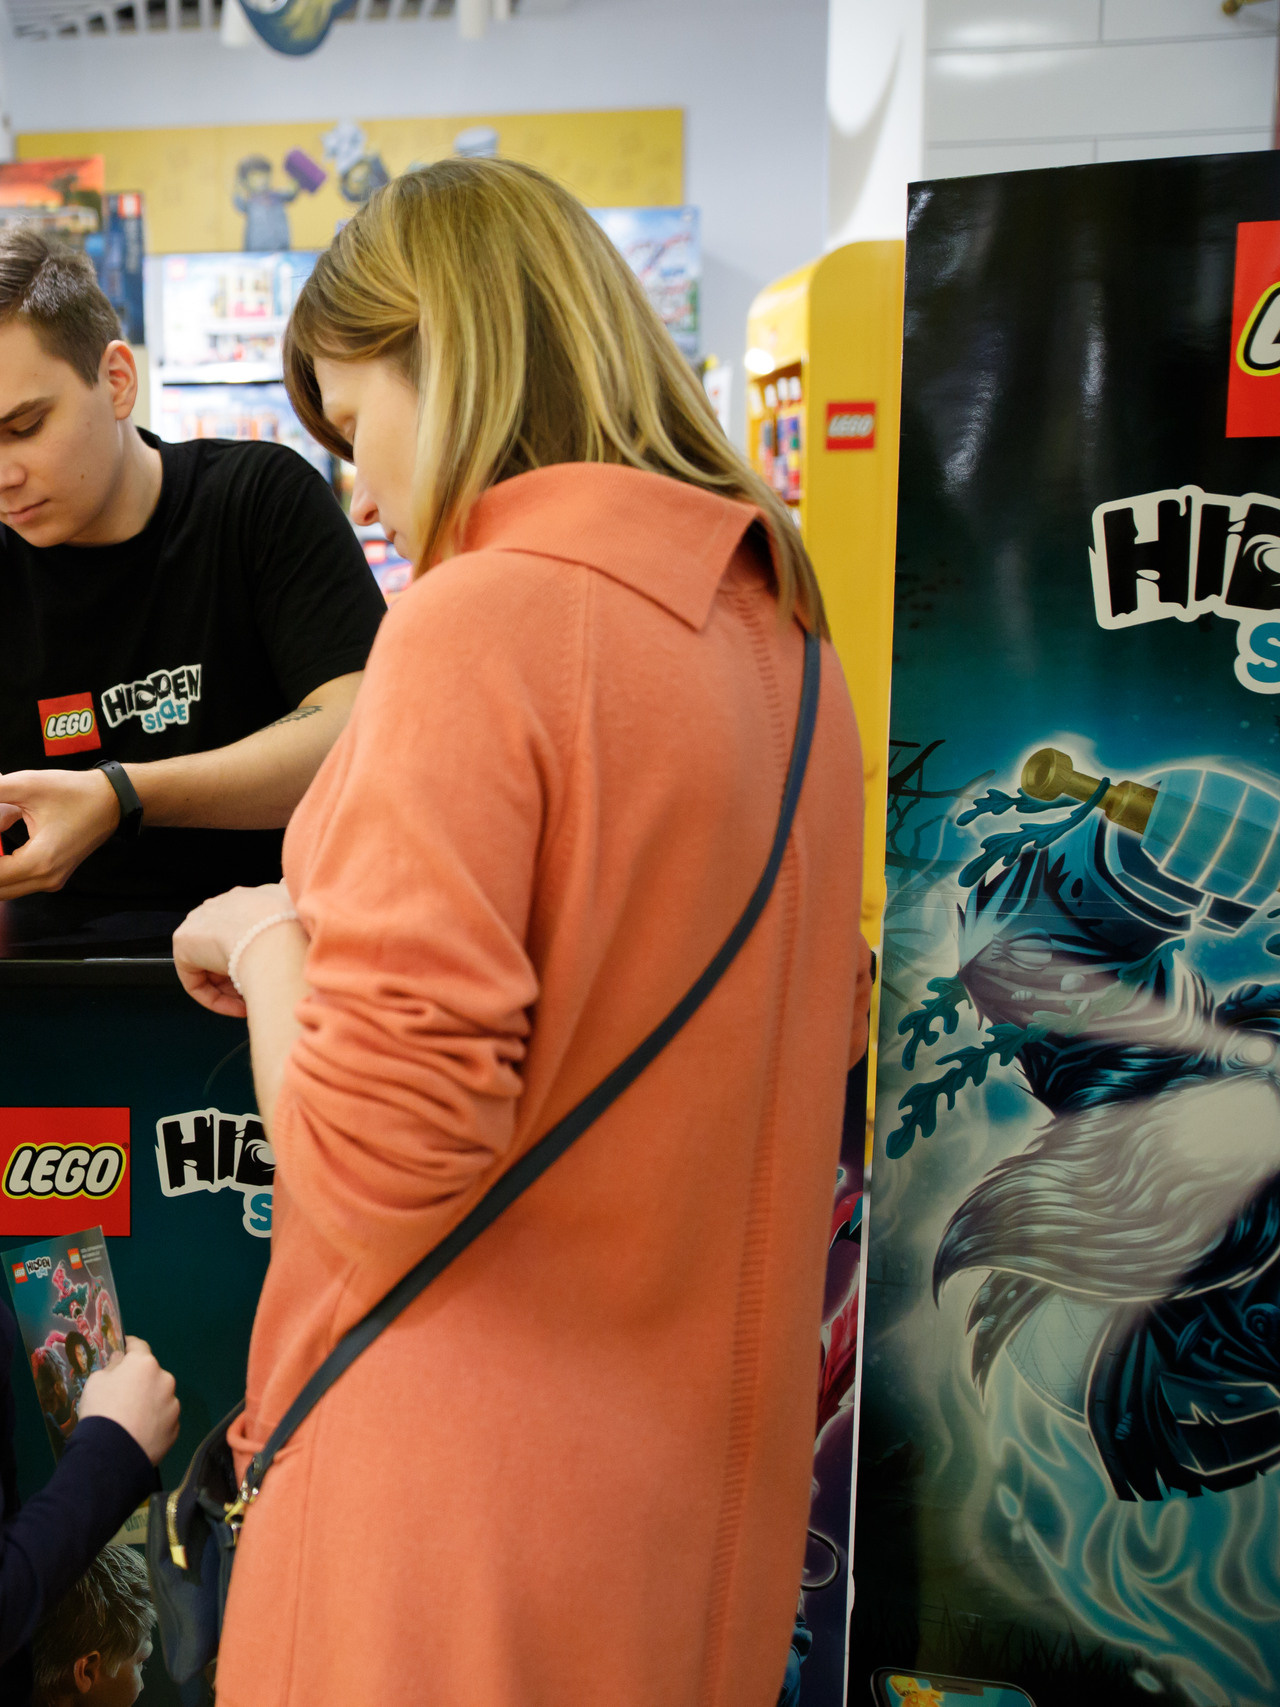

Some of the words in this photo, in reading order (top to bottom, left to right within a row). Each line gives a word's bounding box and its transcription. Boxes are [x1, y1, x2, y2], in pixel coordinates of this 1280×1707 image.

[828, 413, 874, 437] LEGO
[1101, 492, 1280, 619] HID
[102, 665, 201, 726] HIDDEN
[144, 699, 187, 731] SIDE
[45, 709, 93, 739] LEGO
[5, 1146, 123, 1197] LEGO
[160, 1111, 277, 1192] HID
